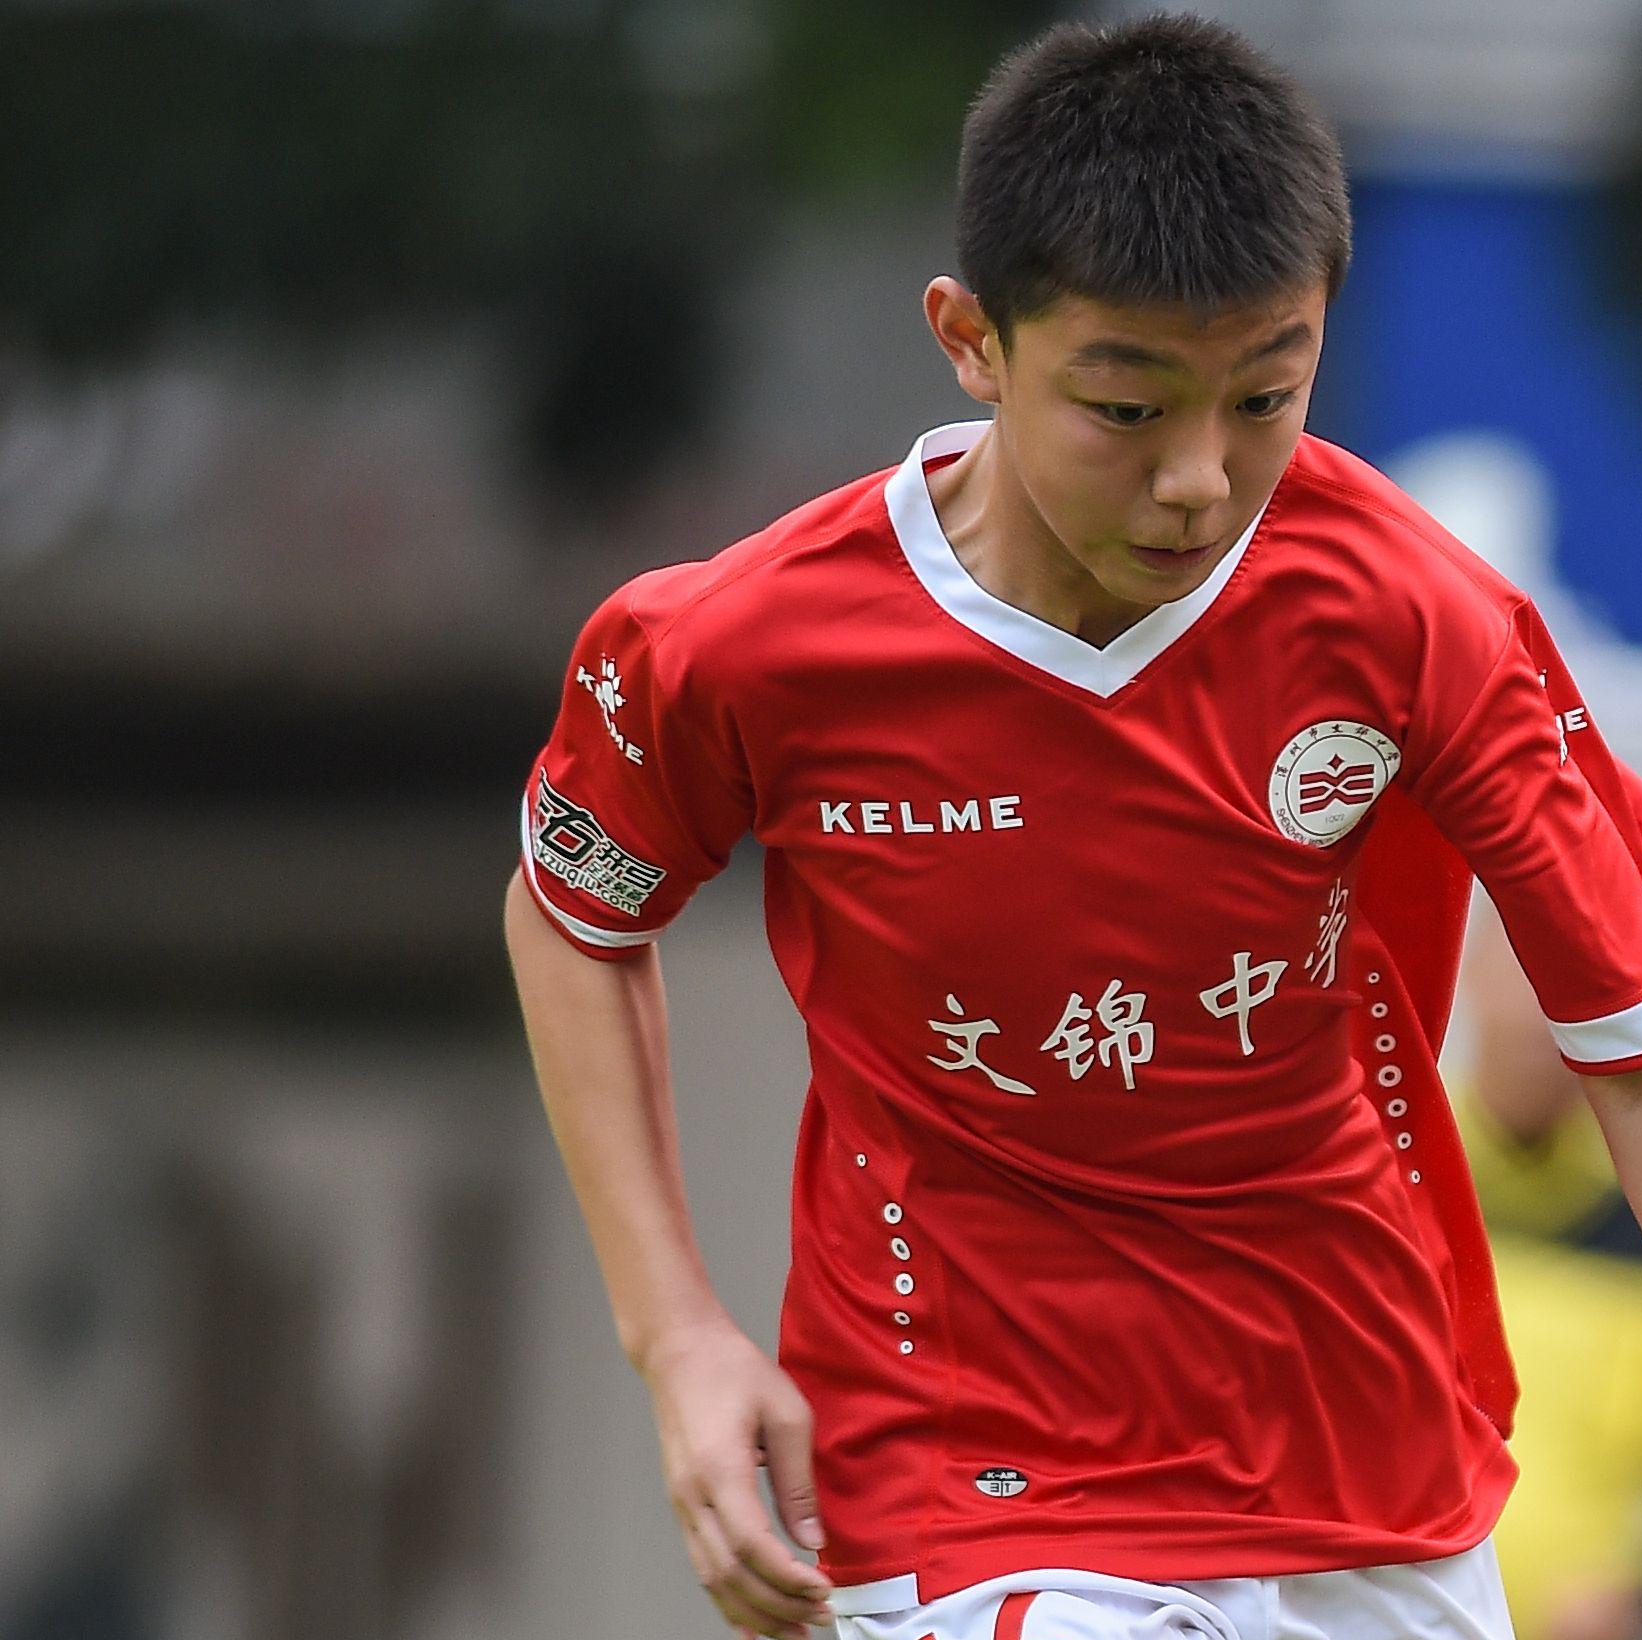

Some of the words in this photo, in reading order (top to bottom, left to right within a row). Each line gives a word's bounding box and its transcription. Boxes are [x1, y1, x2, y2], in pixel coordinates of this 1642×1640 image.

[821, 795, 1024, 834] KELME
[926, 877, 1349, 1096] 文锦中学
